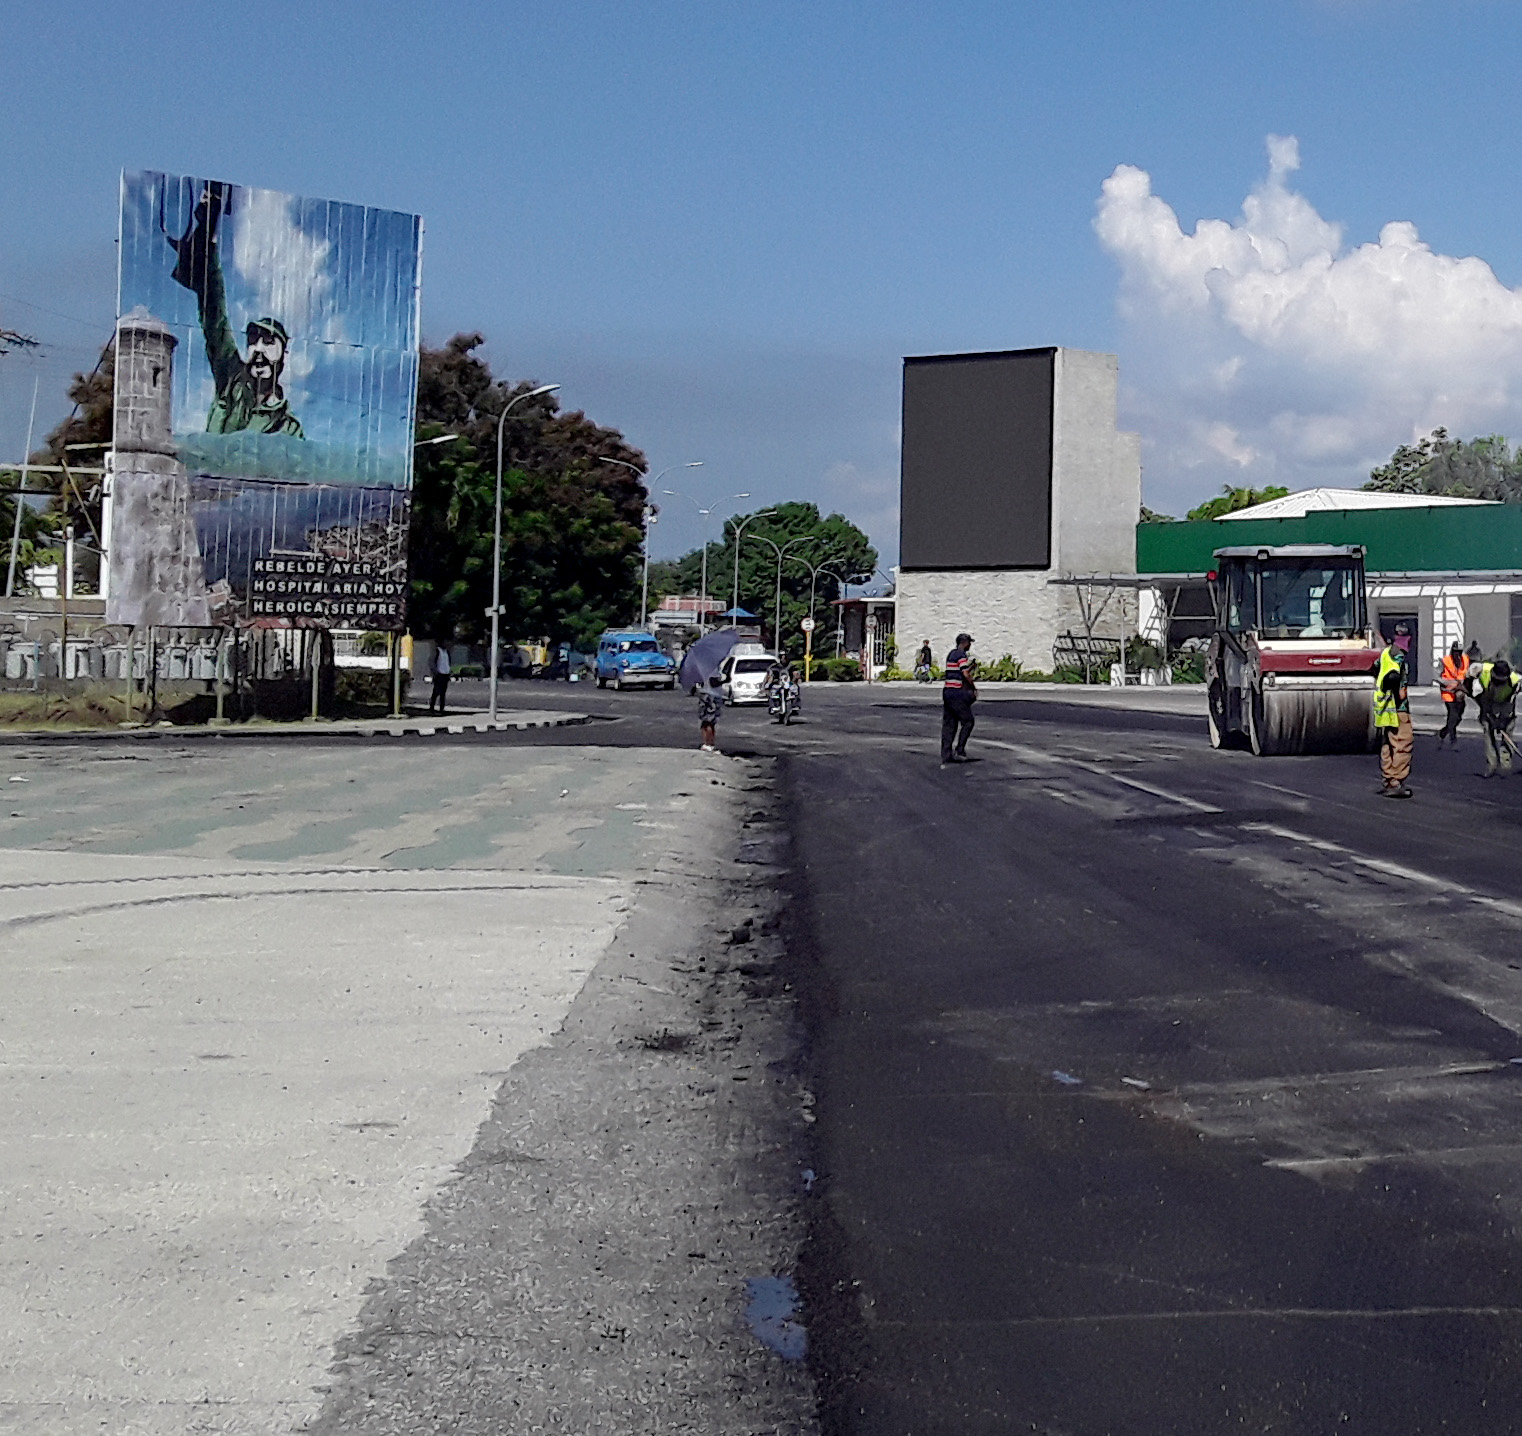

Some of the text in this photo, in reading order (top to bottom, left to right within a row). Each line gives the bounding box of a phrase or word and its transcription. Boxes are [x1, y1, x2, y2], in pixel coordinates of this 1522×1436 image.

[254, 560, 326, 573] REBELDE
[253, 580, 405, 595] HOSPITALARIA HOY
[331, 603, 397, 615] SIEMPRE
